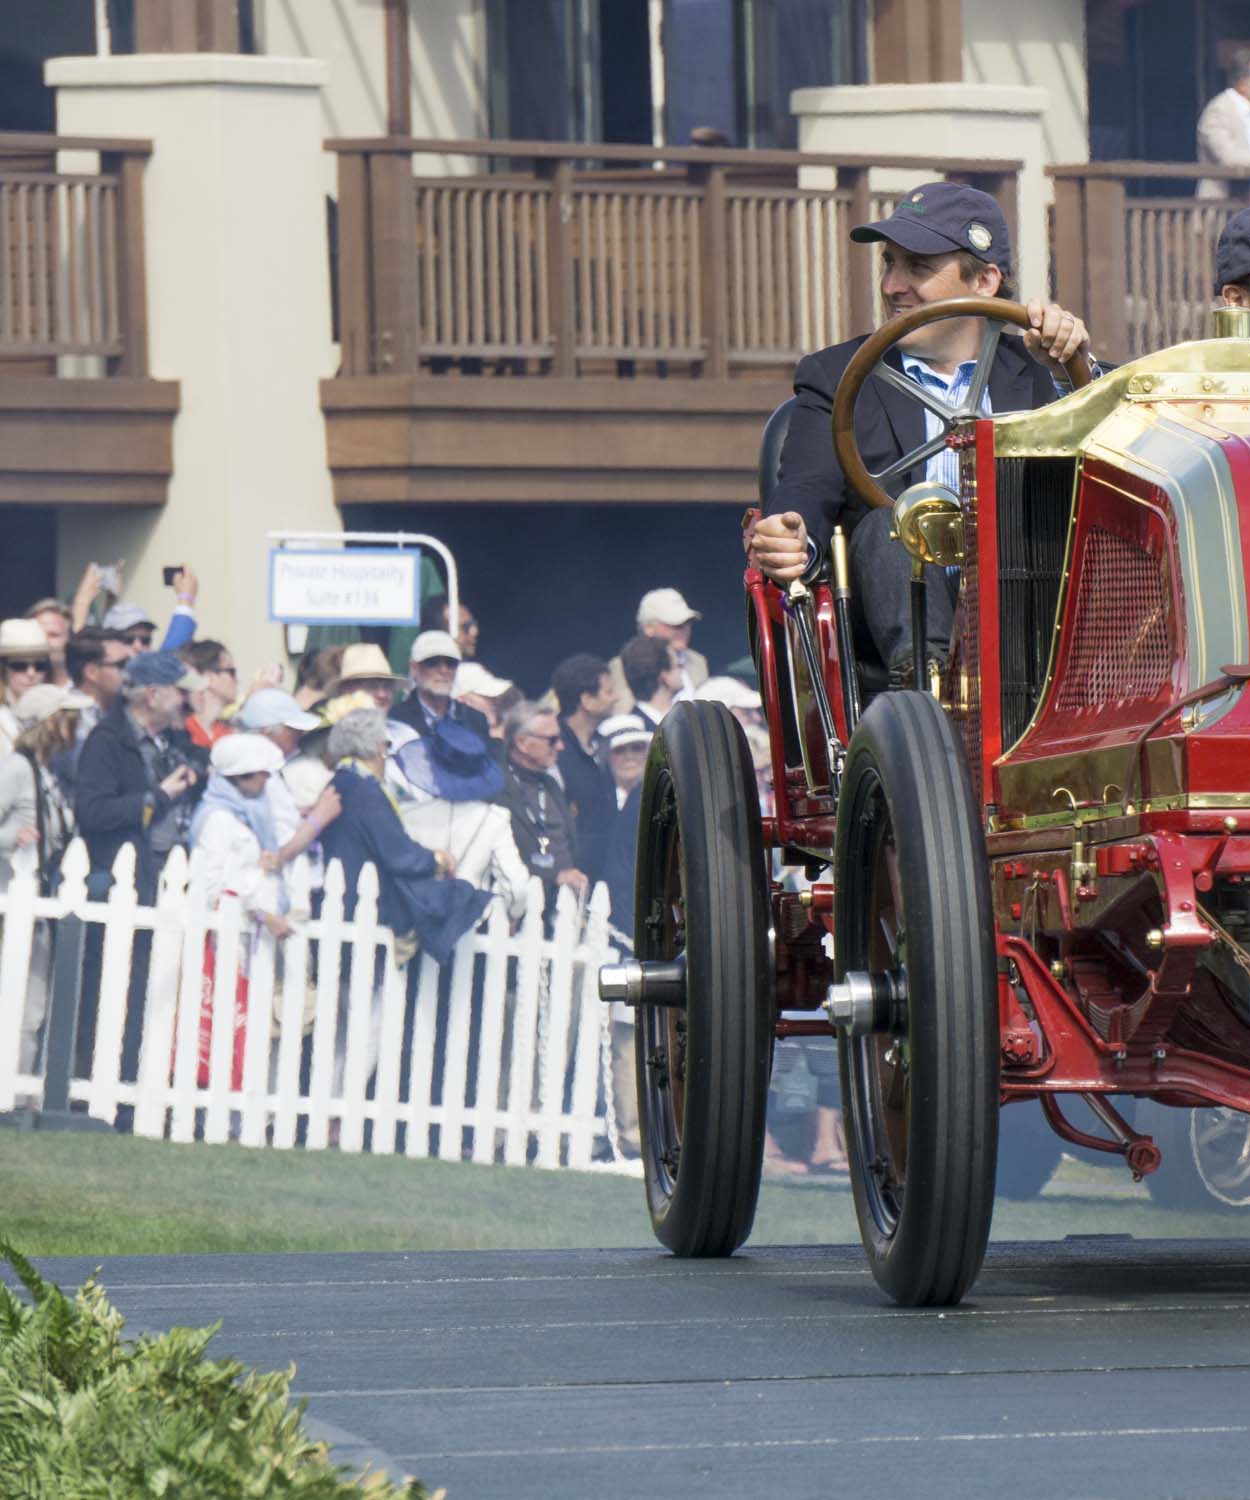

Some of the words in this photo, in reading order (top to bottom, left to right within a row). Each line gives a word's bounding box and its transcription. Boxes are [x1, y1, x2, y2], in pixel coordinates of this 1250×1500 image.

[281, 562, 328, 578] Private
[332, 561, 405, 584] Hospitality
[305, 590, 340, 606] Suite
